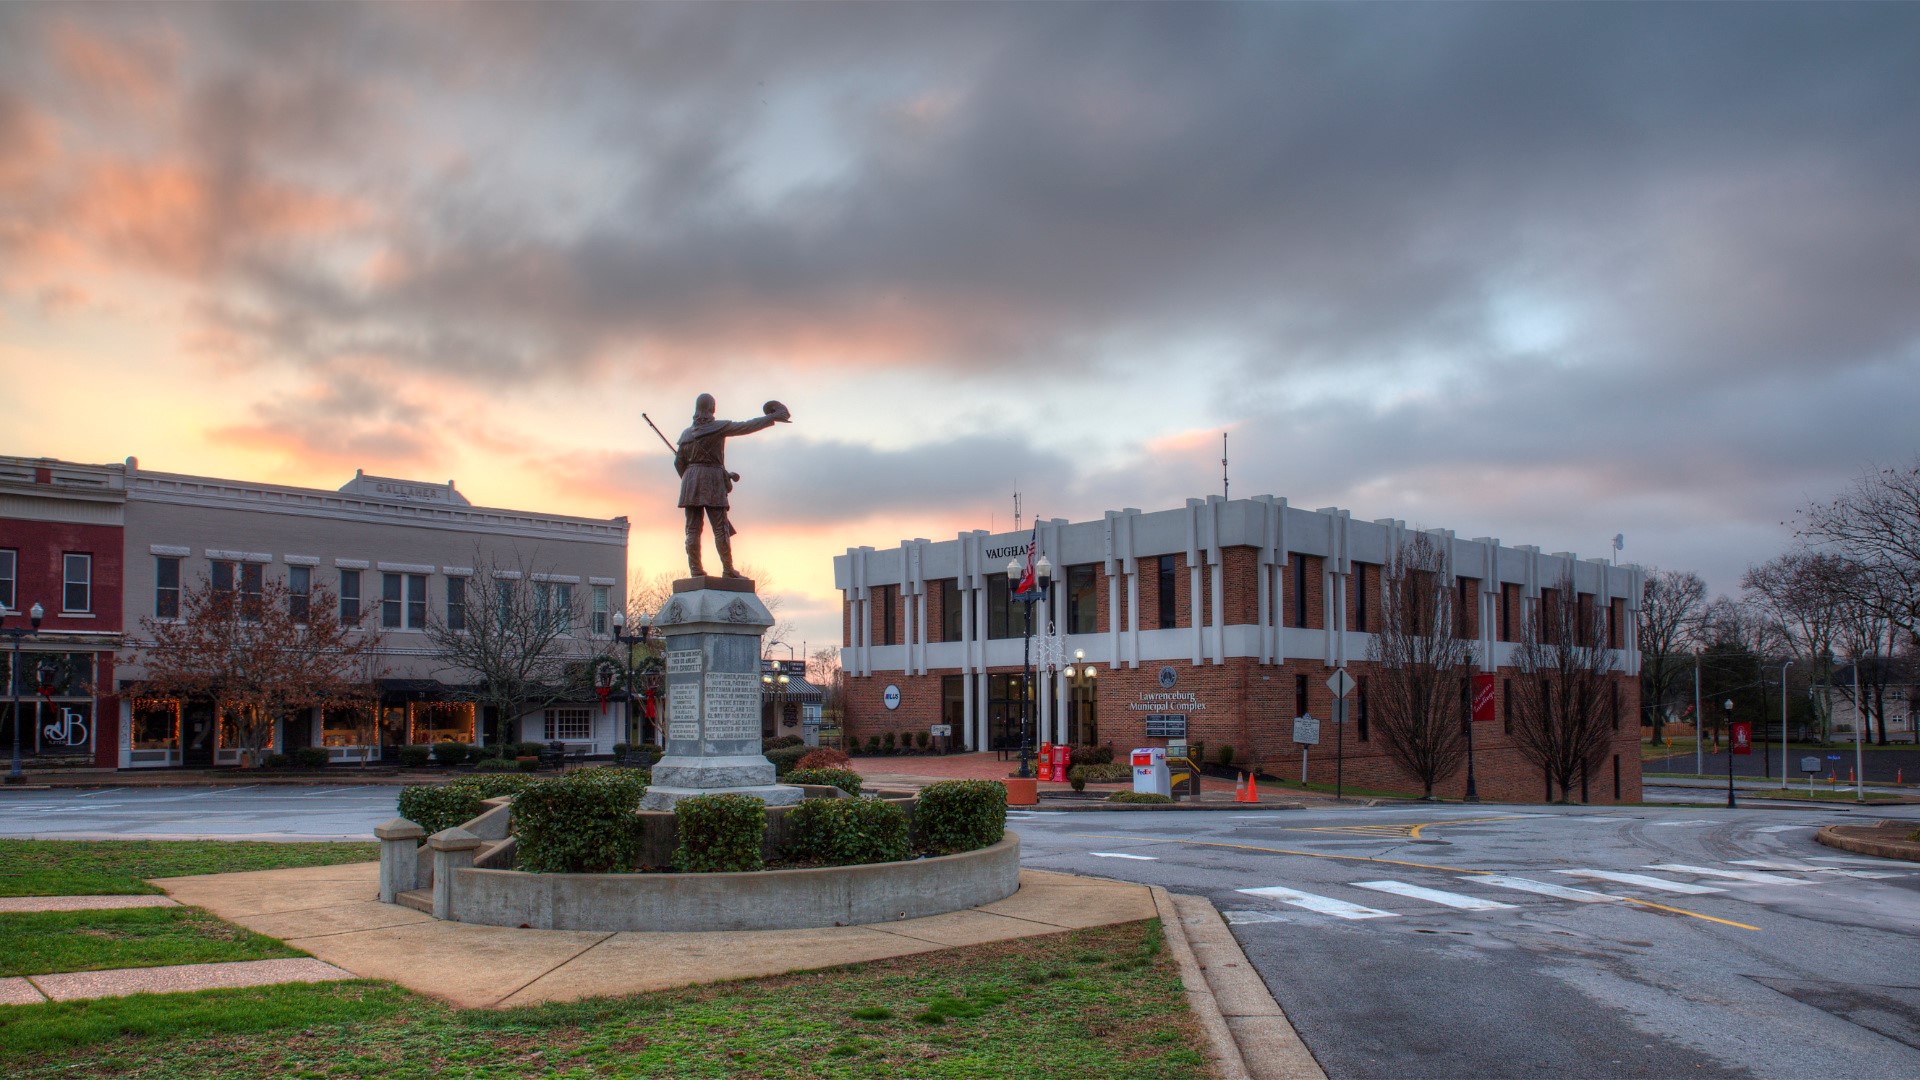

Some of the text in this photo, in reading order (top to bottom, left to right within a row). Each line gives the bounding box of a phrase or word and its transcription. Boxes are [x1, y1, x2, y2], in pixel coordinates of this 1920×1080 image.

[1140, 691, 1196, 702] Lawrenceburg
[1130, 701, 1206, 712] Municipal Complex
